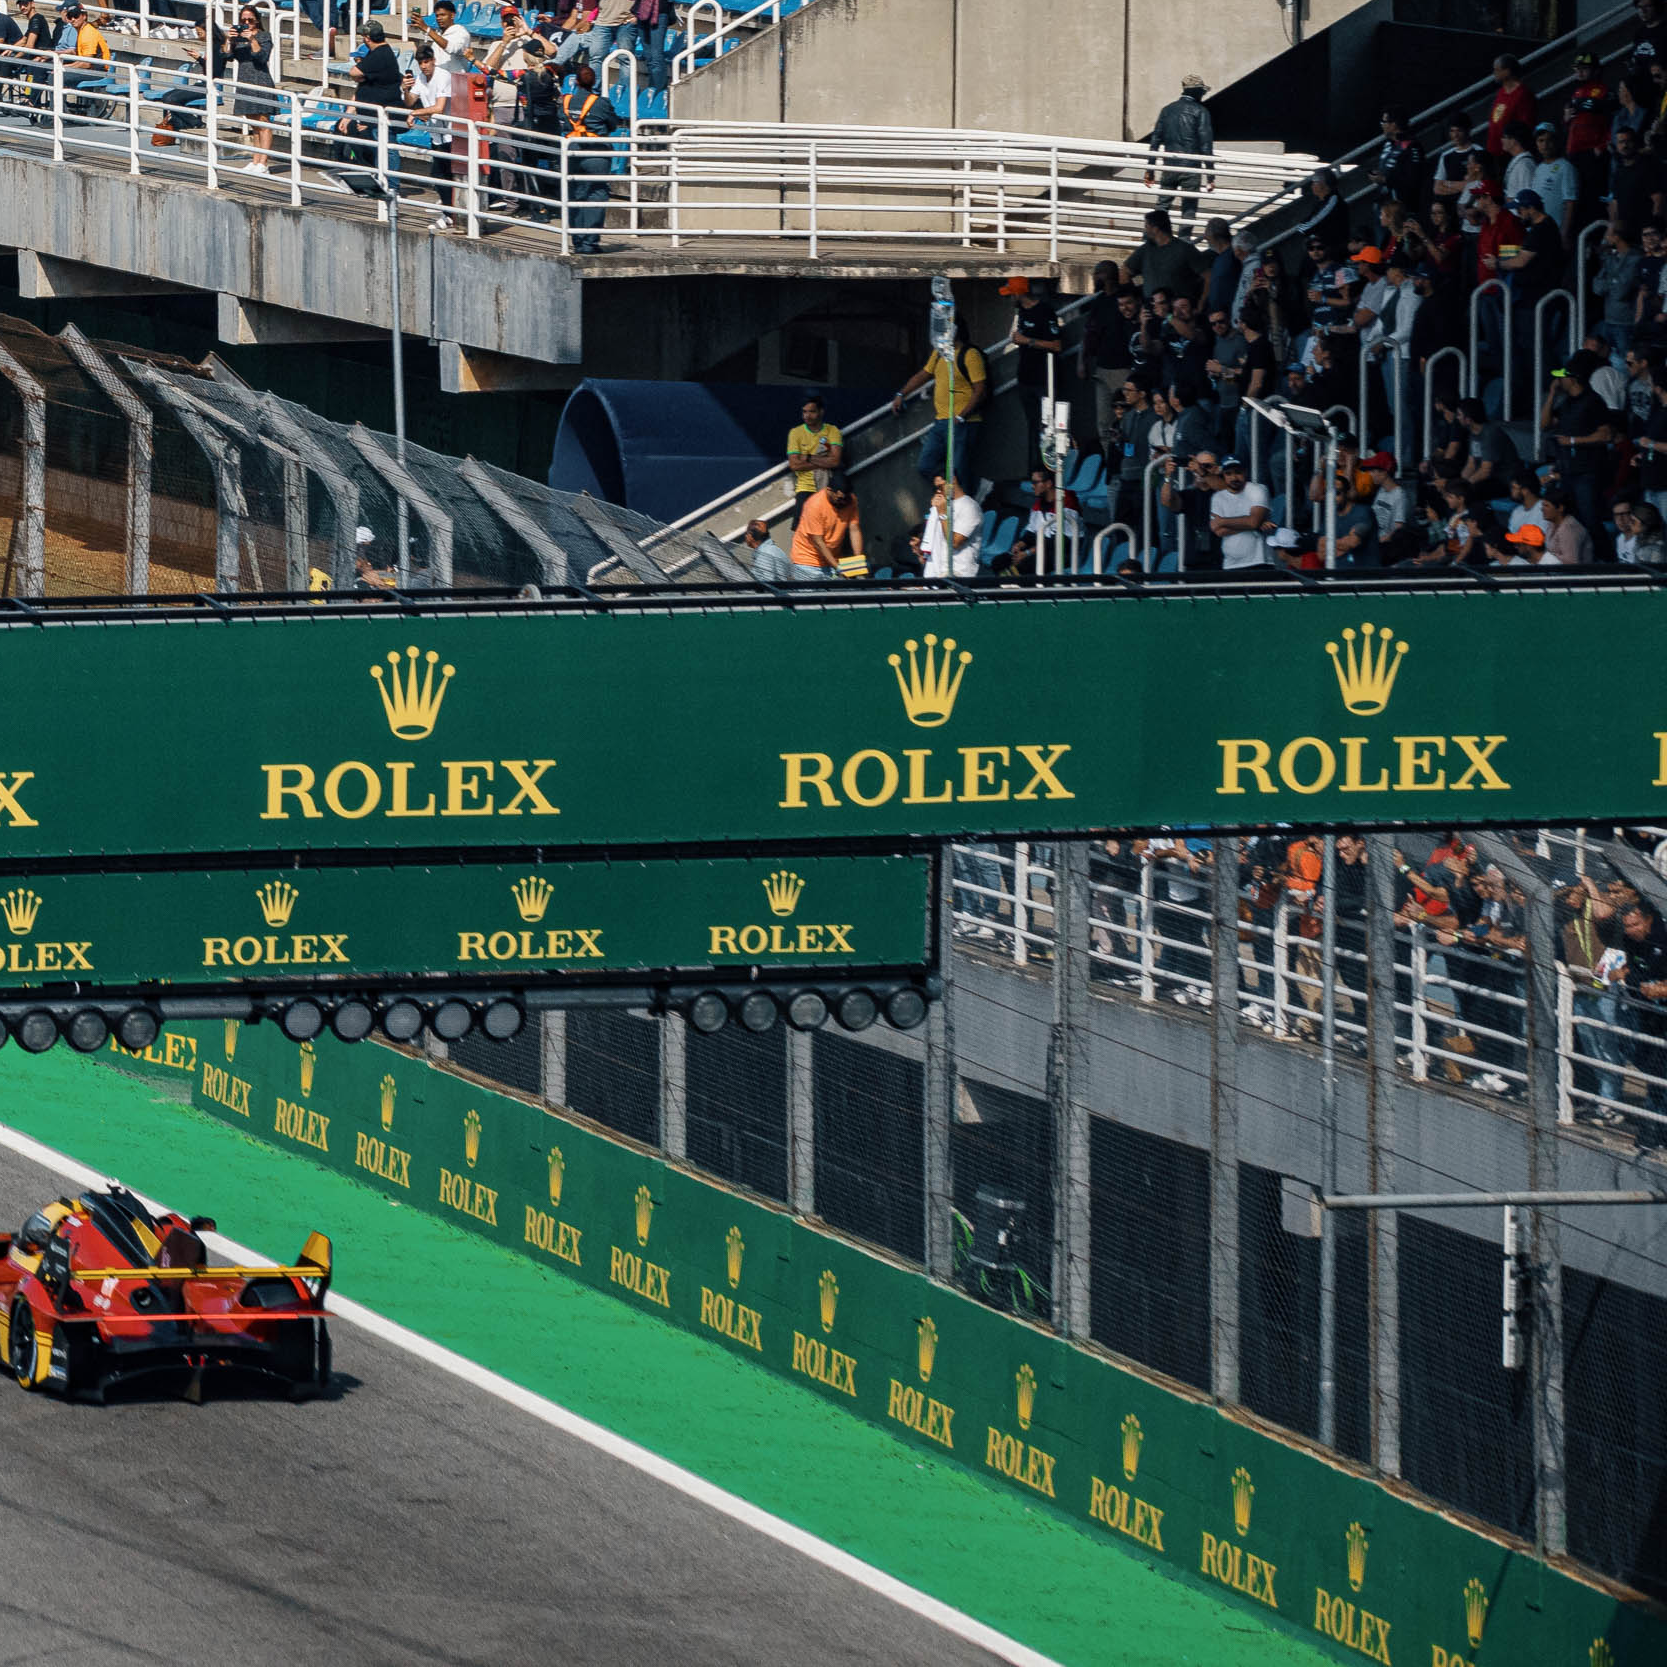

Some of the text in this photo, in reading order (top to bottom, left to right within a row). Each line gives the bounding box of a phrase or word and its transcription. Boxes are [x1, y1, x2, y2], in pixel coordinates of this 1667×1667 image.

[261, 760, 559, 818] ROLEX
[779, 745, 1074, 807] ROLEX
[1217, 736, 1510, 793] ROLEX
[203, 934, 350, 966] ROLEX
[458, 929, 604, 960] ROLEX
[709, 925, 855, 954] ROLEX
[203, 1063, 251, 1116] ROLEX
[355, 1132, 411, 1188] ROLEX
[439, 1168, 498, 1226] ROLEX
[611, 1247, 670, 1308] ROLEX
[792, 1332, 857, 1396] ROLEX
[986, 1428, 1056, 1498] ROLEX
[1201, 1532, 1278, 1608] ROLEX
[1315, 1588, 1391, 1666] ROLEX
